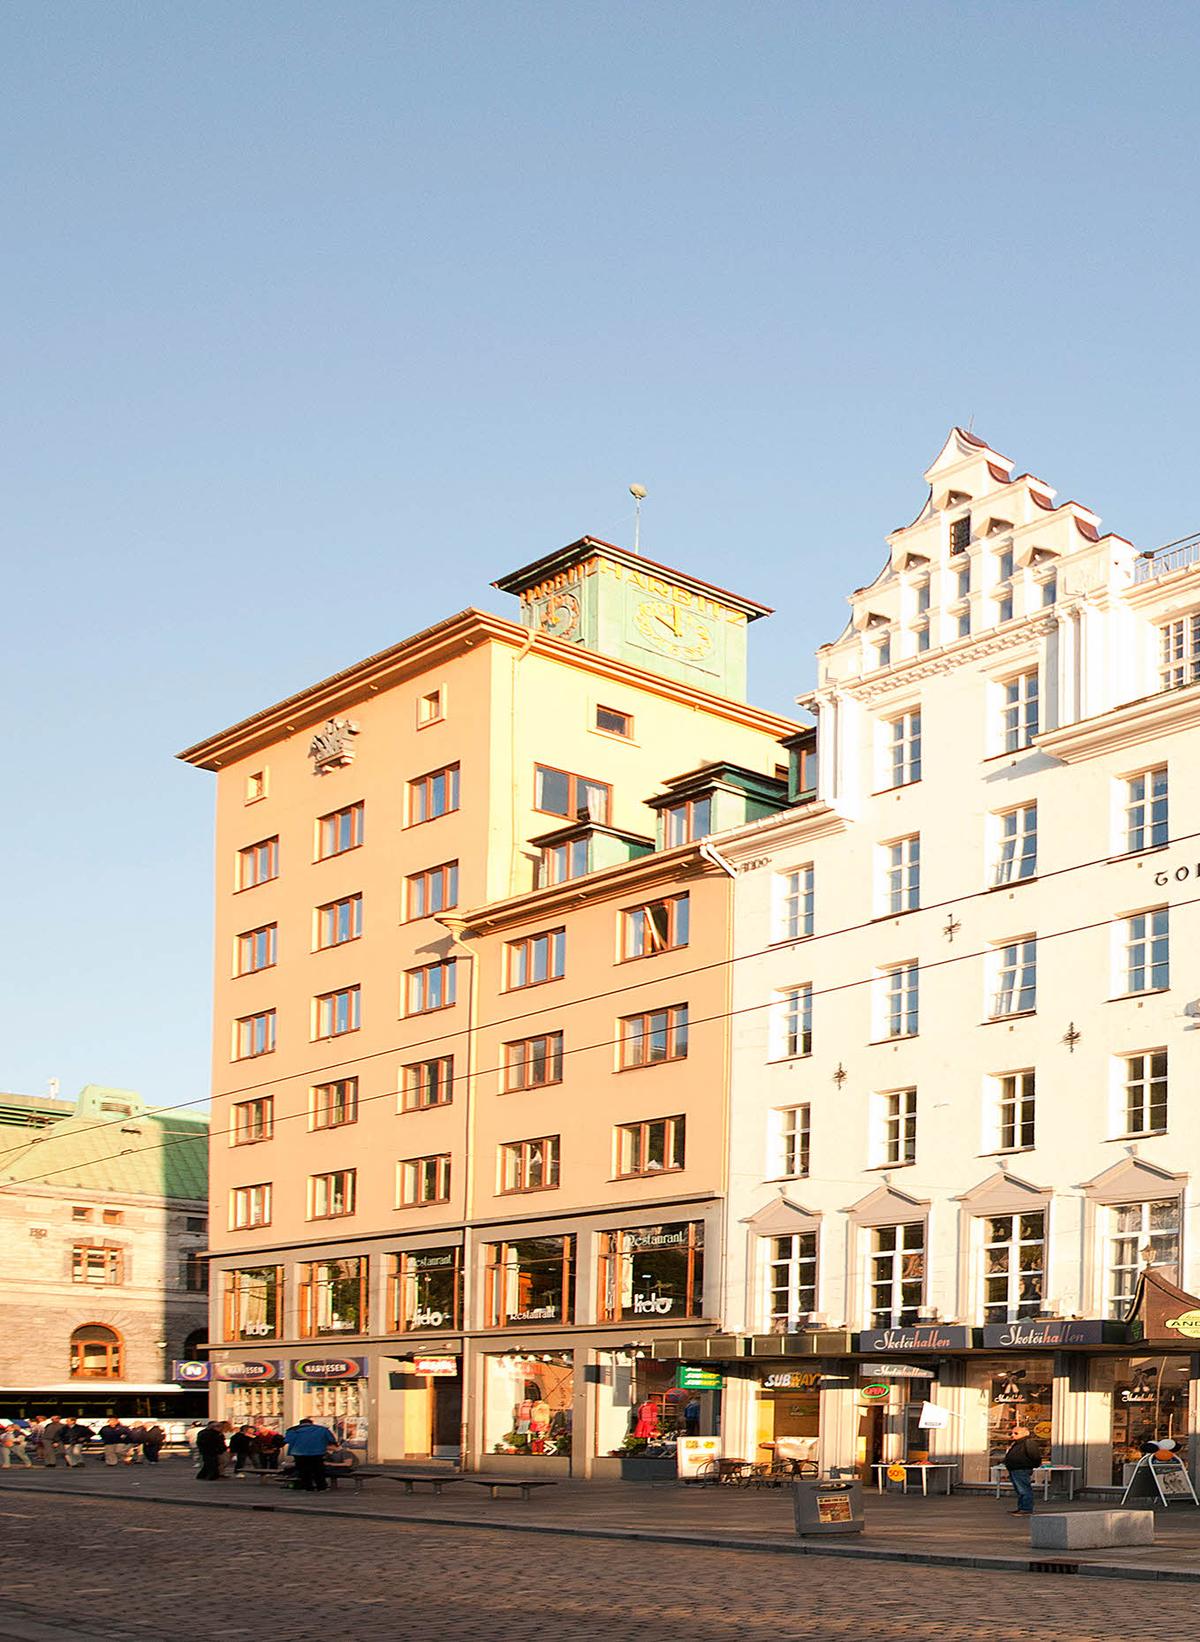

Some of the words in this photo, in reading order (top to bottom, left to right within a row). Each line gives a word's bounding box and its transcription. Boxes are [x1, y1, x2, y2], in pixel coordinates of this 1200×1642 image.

[598, 556, 747, 628] HARBITZ
[624, 1230, 684, 1247] Restaurant
[634, 1292, 673, 1314] lido
[305, 1363, 347, 1374] NARVESEN
[764, 1373, 819, 1388] SUBWAY
